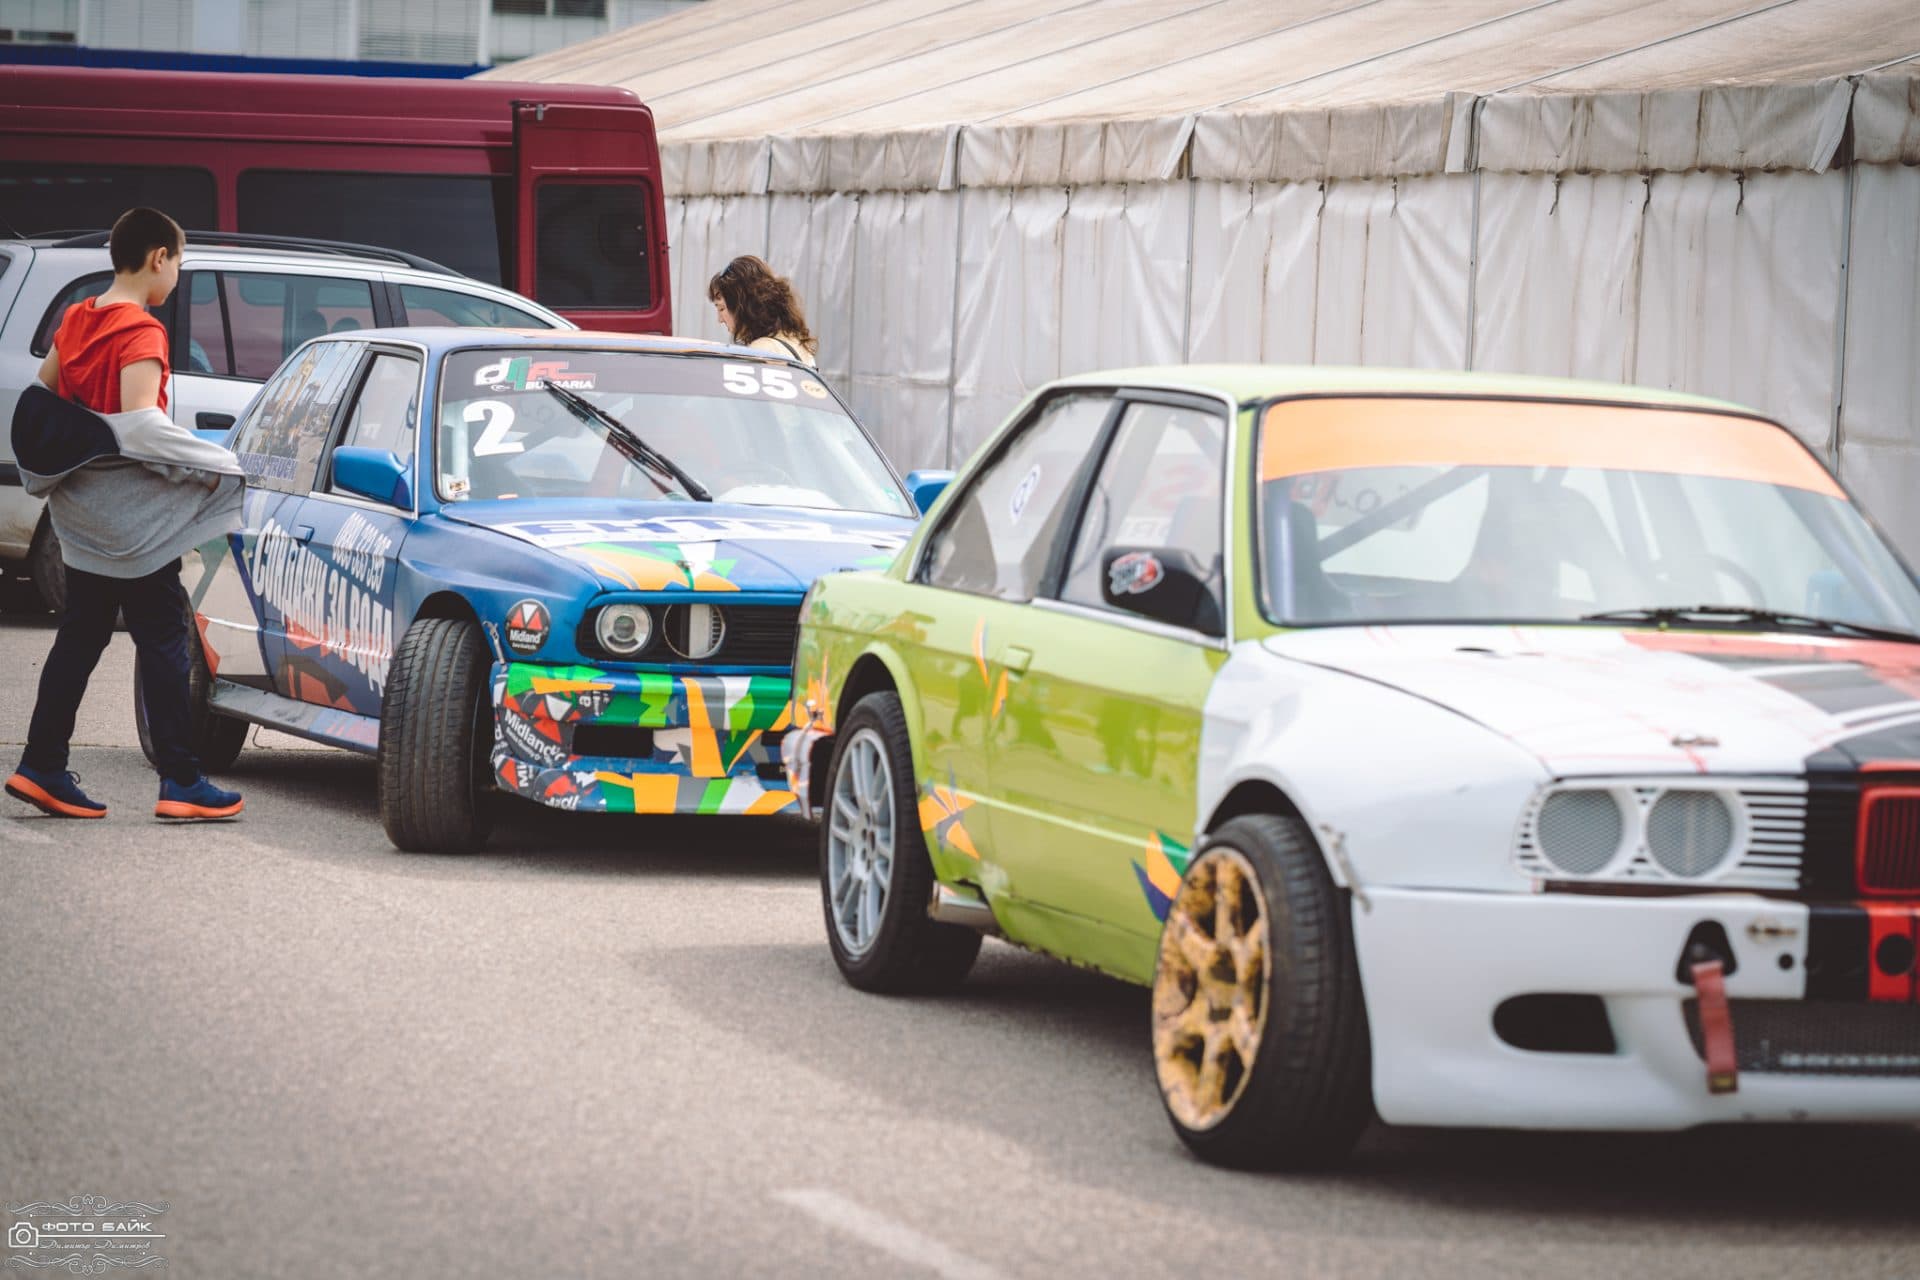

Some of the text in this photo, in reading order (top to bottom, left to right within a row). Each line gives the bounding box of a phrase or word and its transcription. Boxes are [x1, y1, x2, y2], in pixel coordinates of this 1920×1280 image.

[722, 364, 798, 399] 55
[463, 400, 525, 457] 2
[327, 569, 348, 655] ЗА
[509, 629, 542, 644] Midland
